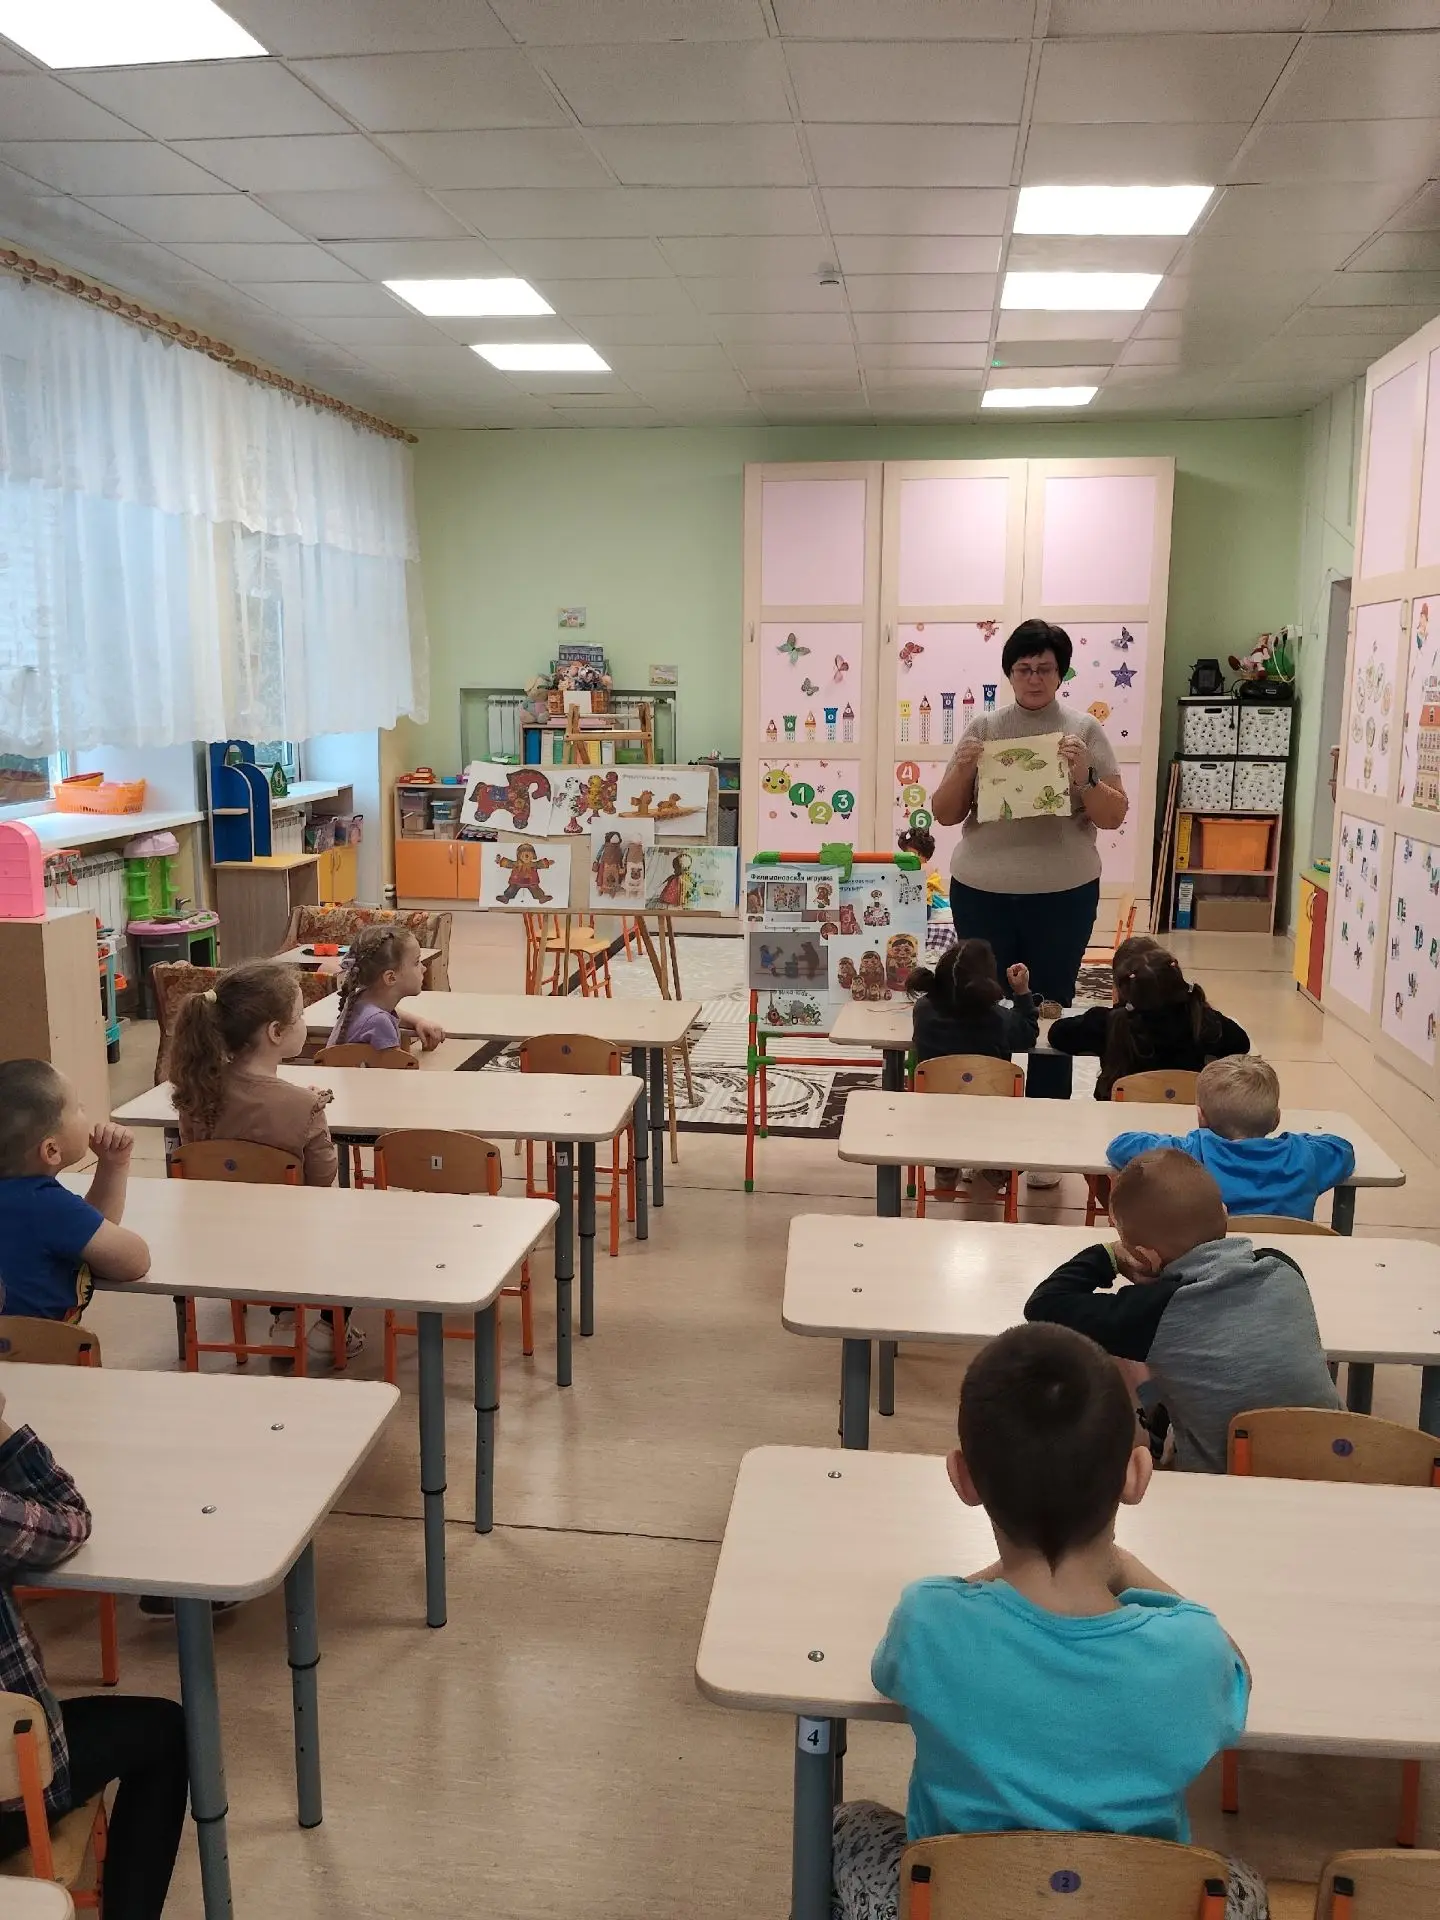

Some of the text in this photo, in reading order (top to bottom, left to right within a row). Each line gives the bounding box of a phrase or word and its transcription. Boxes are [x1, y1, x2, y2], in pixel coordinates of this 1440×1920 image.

[901, 765, 913, 780] 4
[798, 786, 805, 803] 1
[837, 794, 849, 809] 3
[909, 788, 921, 803] 5
[815, 806, 827, 820] 2
[915, 812, 927, 828] 6
[807, 1729, 820, 1746] 4
[1061, 1877, 1070, 1888] 2
